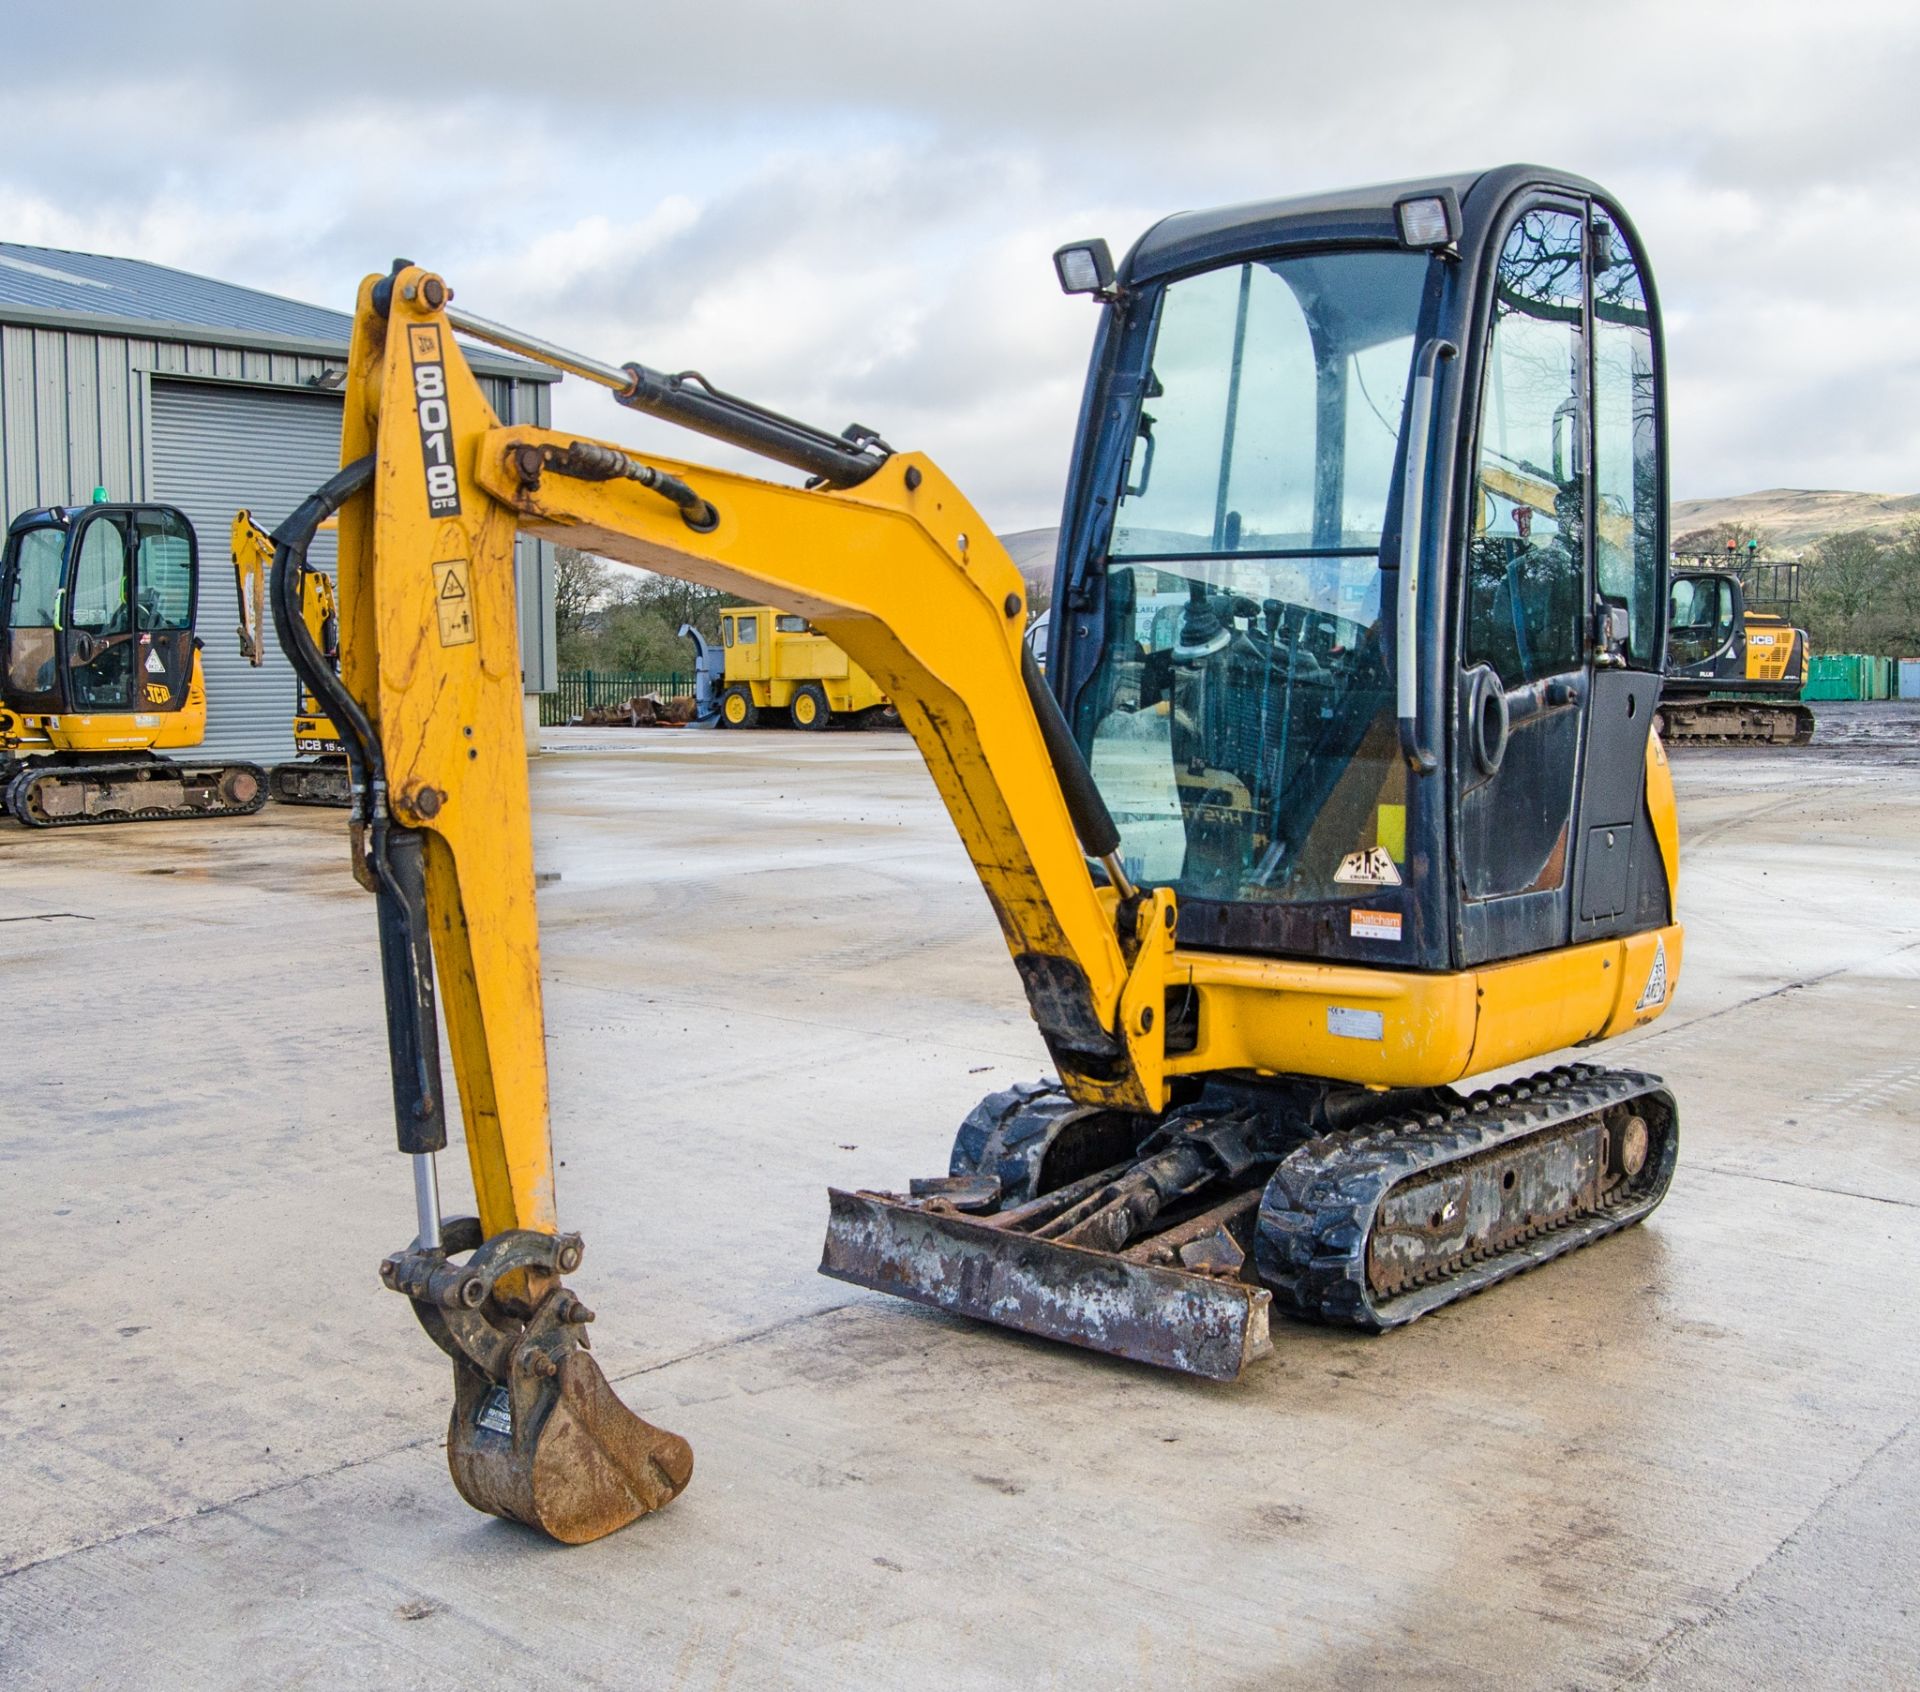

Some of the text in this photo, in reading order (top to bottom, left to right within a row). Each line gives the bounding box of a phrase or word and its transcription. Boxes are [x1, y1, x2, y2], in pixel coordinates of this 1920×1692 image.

[415, 365, 457, 498] 8018
[432, 498, 457, 509] CTS
[1749, 635, 1774, 645] JCB
[146, 685, 169, 705] JCB
[298, 739, 322, 751] JCB
[1353, 912, 1400, 927] Thatcham
